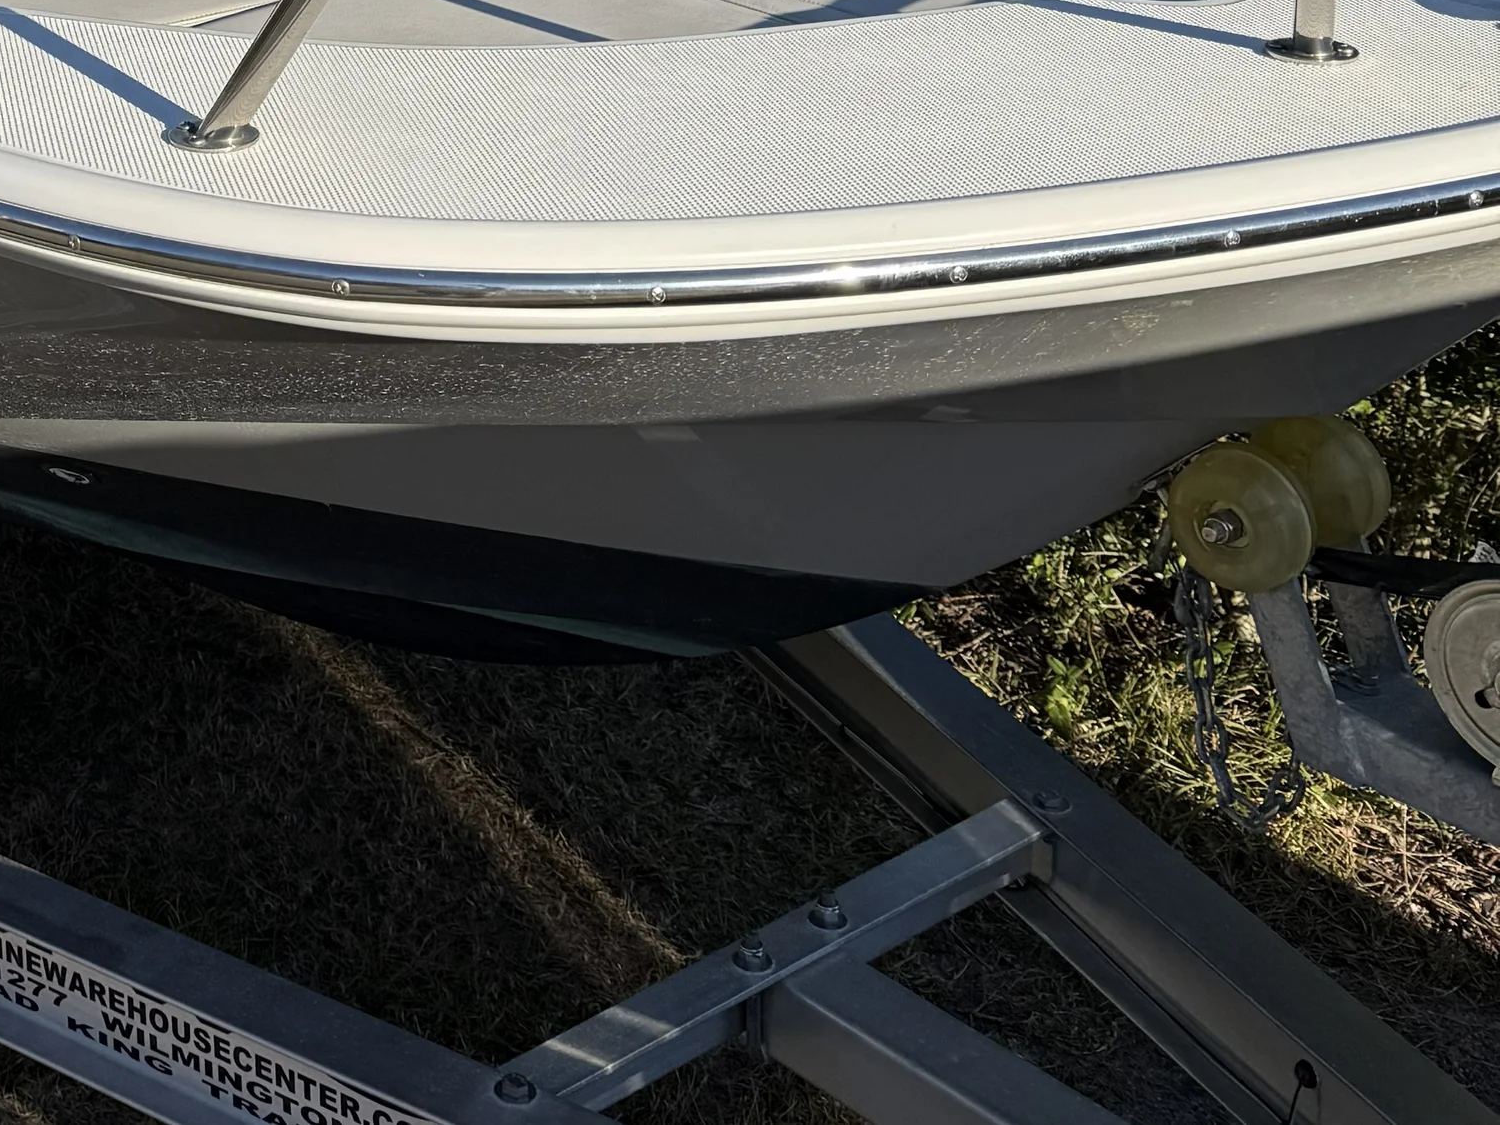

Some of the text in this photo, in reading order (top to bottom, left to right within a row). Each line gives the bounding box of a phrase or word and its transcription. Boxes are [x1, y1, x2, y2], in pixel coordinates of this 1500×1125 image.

[67, 1016, 173, 1076] KING
[202, 1078, 300, 1125] TRA
[101, 1010, 346, 1125] WILMINGTO
